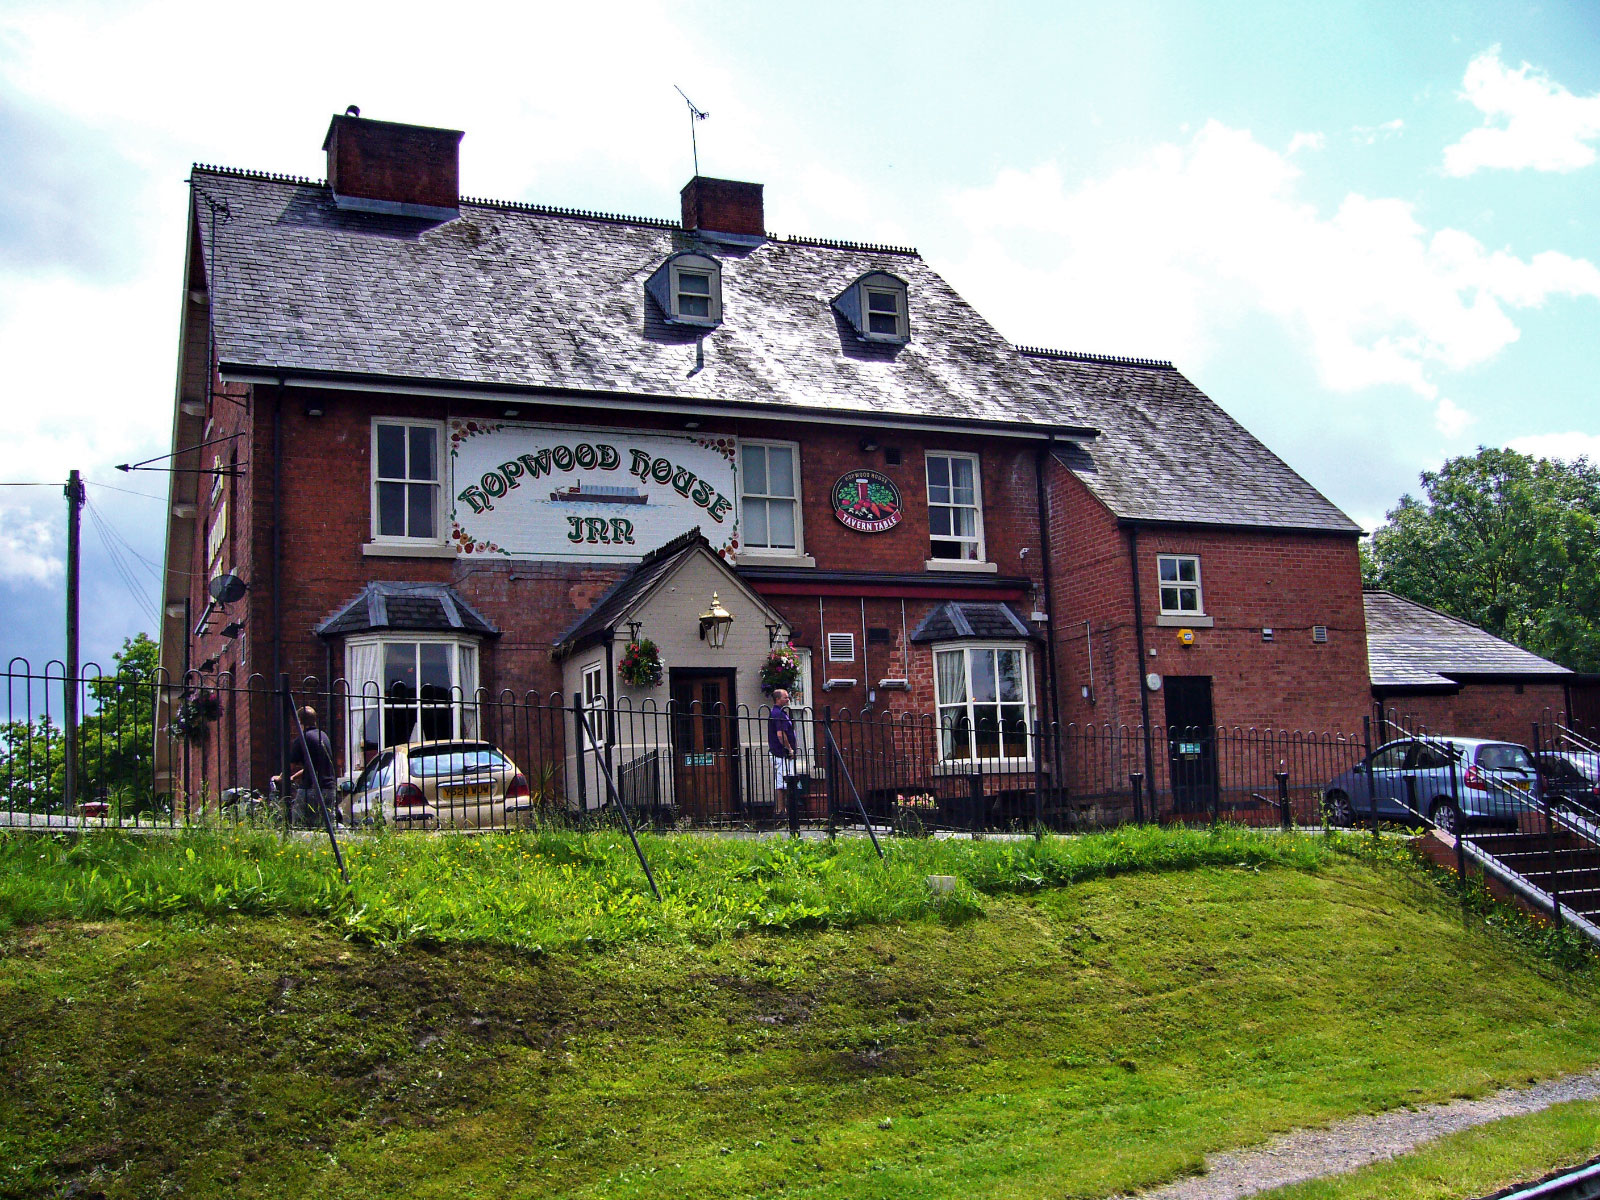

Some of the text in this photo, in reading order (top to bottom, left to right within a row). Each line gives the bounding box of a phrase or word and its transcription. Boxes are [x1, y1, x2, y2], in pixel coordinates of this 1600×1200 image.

[457, 443, 733, 523] HOPWOOD HOUSE
[567, 516, 635, 545] INN
[842, 513, 897, 531] TAVERN TABLE
